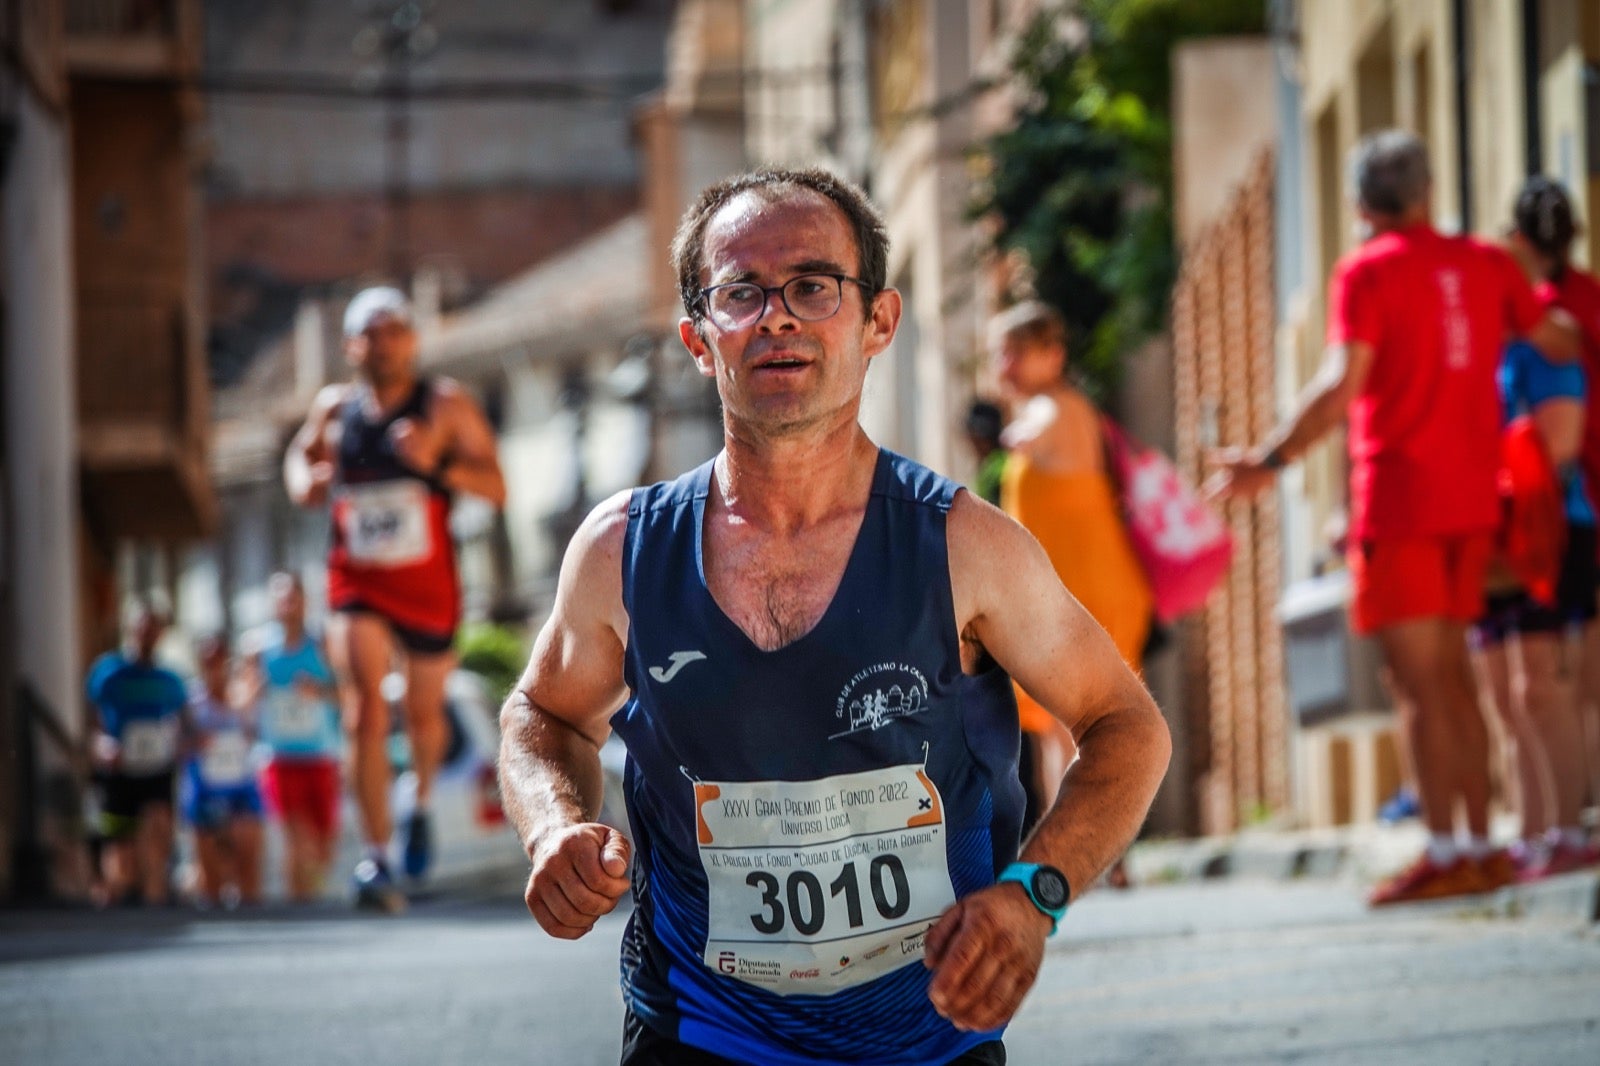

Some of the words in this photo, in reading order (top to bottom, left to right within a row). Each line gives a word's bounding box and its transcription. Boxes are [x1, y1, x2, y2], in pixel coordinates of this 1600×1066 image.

[851, 662, 896, 687] ATLETISMO
[722, 799, 750, 818] XXXV
[755, 798, 782, 817] GRAN
[784, 798, 822, 817] PREMIO
[825, 795, 837, 812] DE
[840, 788, 875, 808] FONDO
[878, 781, 909, 803] 2022
[780, 819, 823, 836] UNIVERSO
[825, 812, 851, 832] LORCA
[722, 853, 752, 868] PRUEBA
[754, 855, 765, 869] DE
[767, 852, 792, 868] FONDO
[831, 849, 842, 862] DE
[877, 837, 898, 852] RUTA
[745, 853, 911, 936] 3010
[738, 957, 781, 969] Diputación
[738, 967, 746, 975] de
[748, 967, 781, 977] Granada
